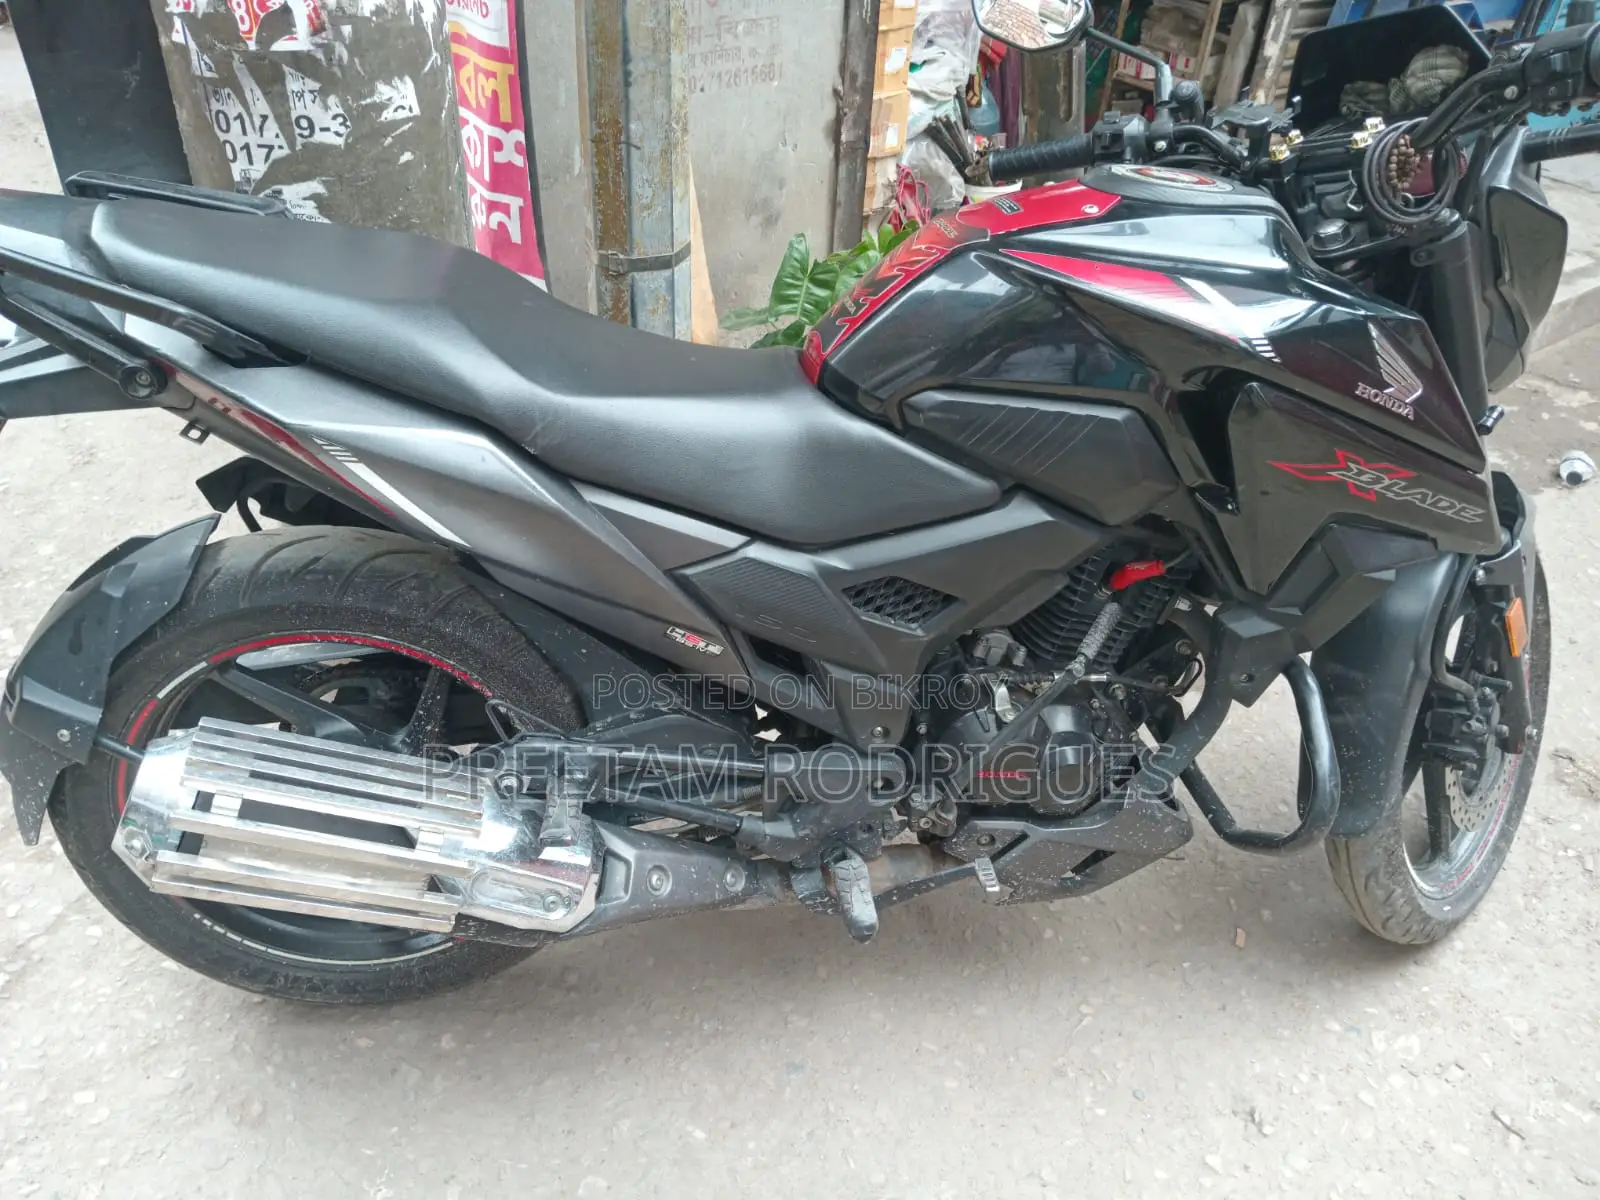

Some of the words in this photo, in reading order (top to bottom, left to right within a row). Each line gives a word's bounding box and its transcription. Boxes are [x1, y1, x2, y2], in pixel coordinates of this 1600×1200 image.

[214, 108, 280, 139] 017
[221, 139, 285, 166] 017
[1354, 382, 1415, 421] HONDA
